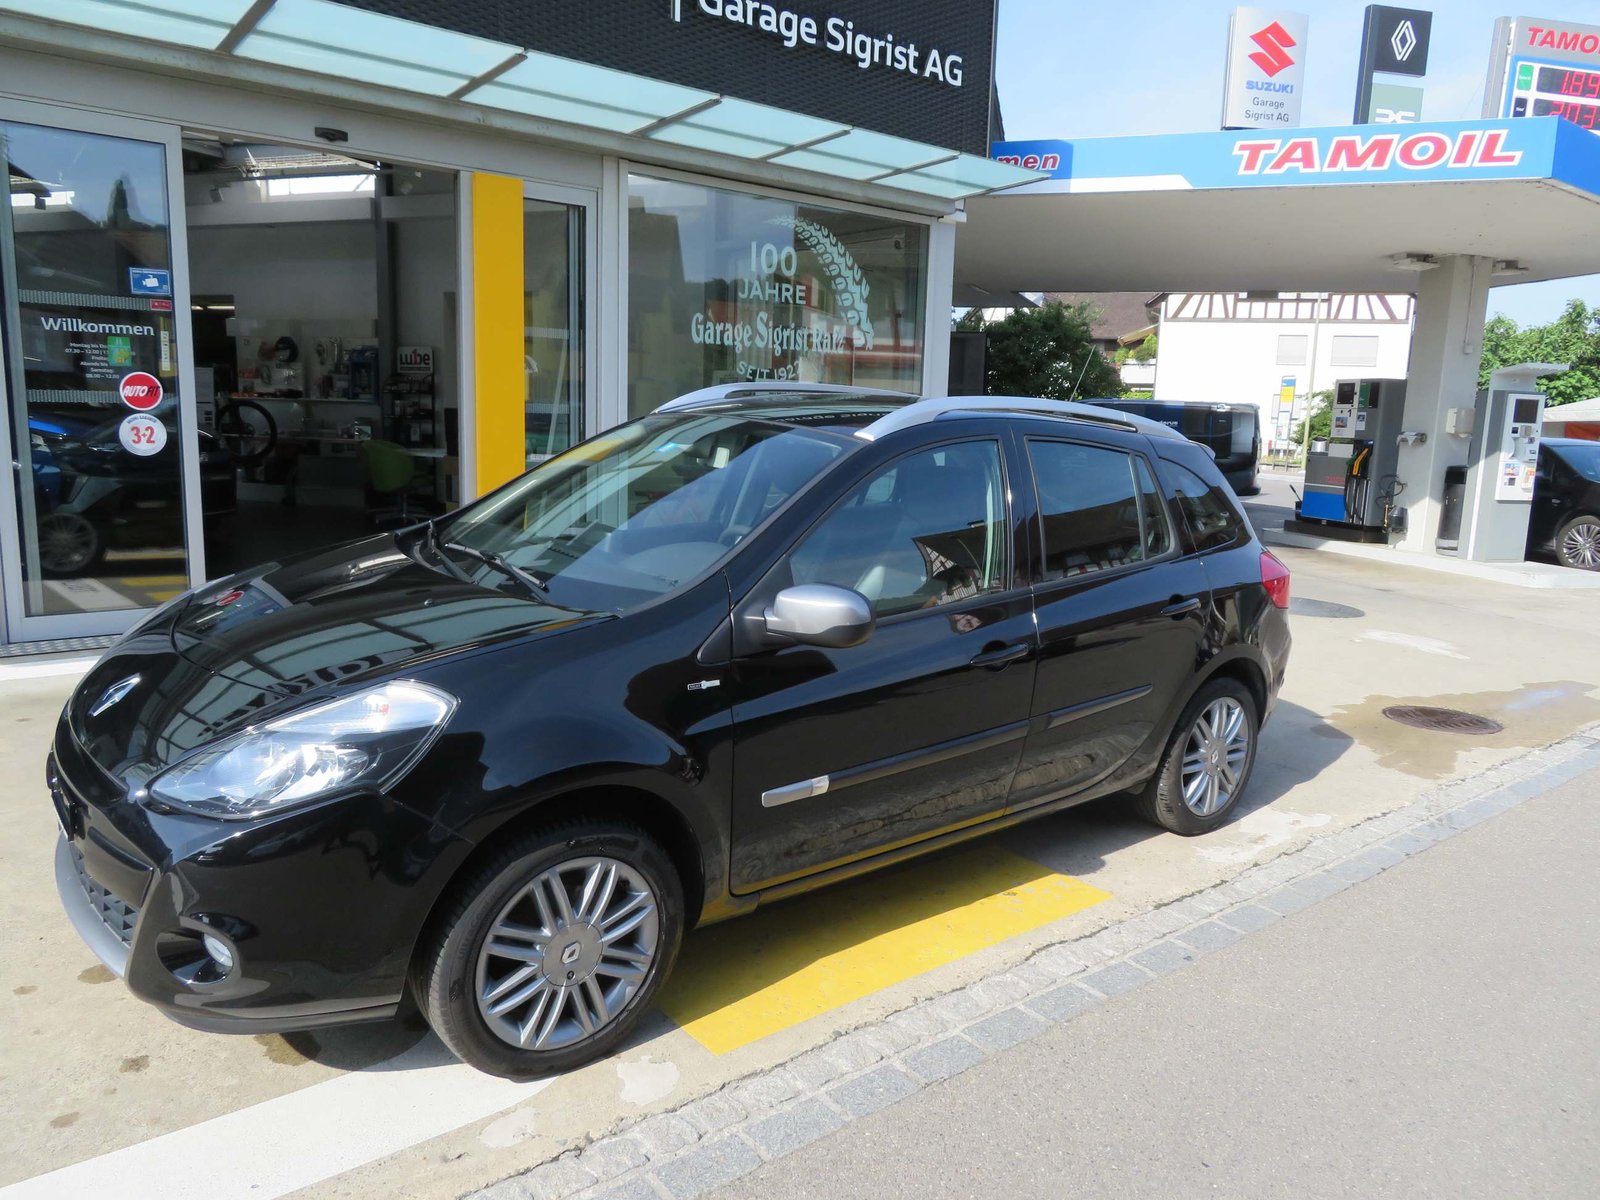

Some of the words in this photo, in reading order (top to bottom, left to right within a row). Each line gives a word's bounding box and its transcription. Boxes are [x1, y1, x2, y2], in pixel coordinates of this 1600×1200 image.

[826, 17, 918, 74] Sigrist
[923, 48, 963, 87] AG
[1527, 25, 1600, 55] TAMO
[1246, 80, 1294, 94] SUZUKI
[1244, 109, 1274, 121] Sigrist
[1276, 112, 1290, 122] AG
[1252, 96, 1285, 109] Garage
[1233, 129, 1524, 175] TAMOIL
[751, 241, 798, 277] 100
[738, 278, 807, 305] JAHRE
[40, 316, 155, 336] Willkommen
[691, 312, 753, 353] Garage
[754, 311, 809, 356] Sigrist
[736, 361, 770, 380] SEIT
